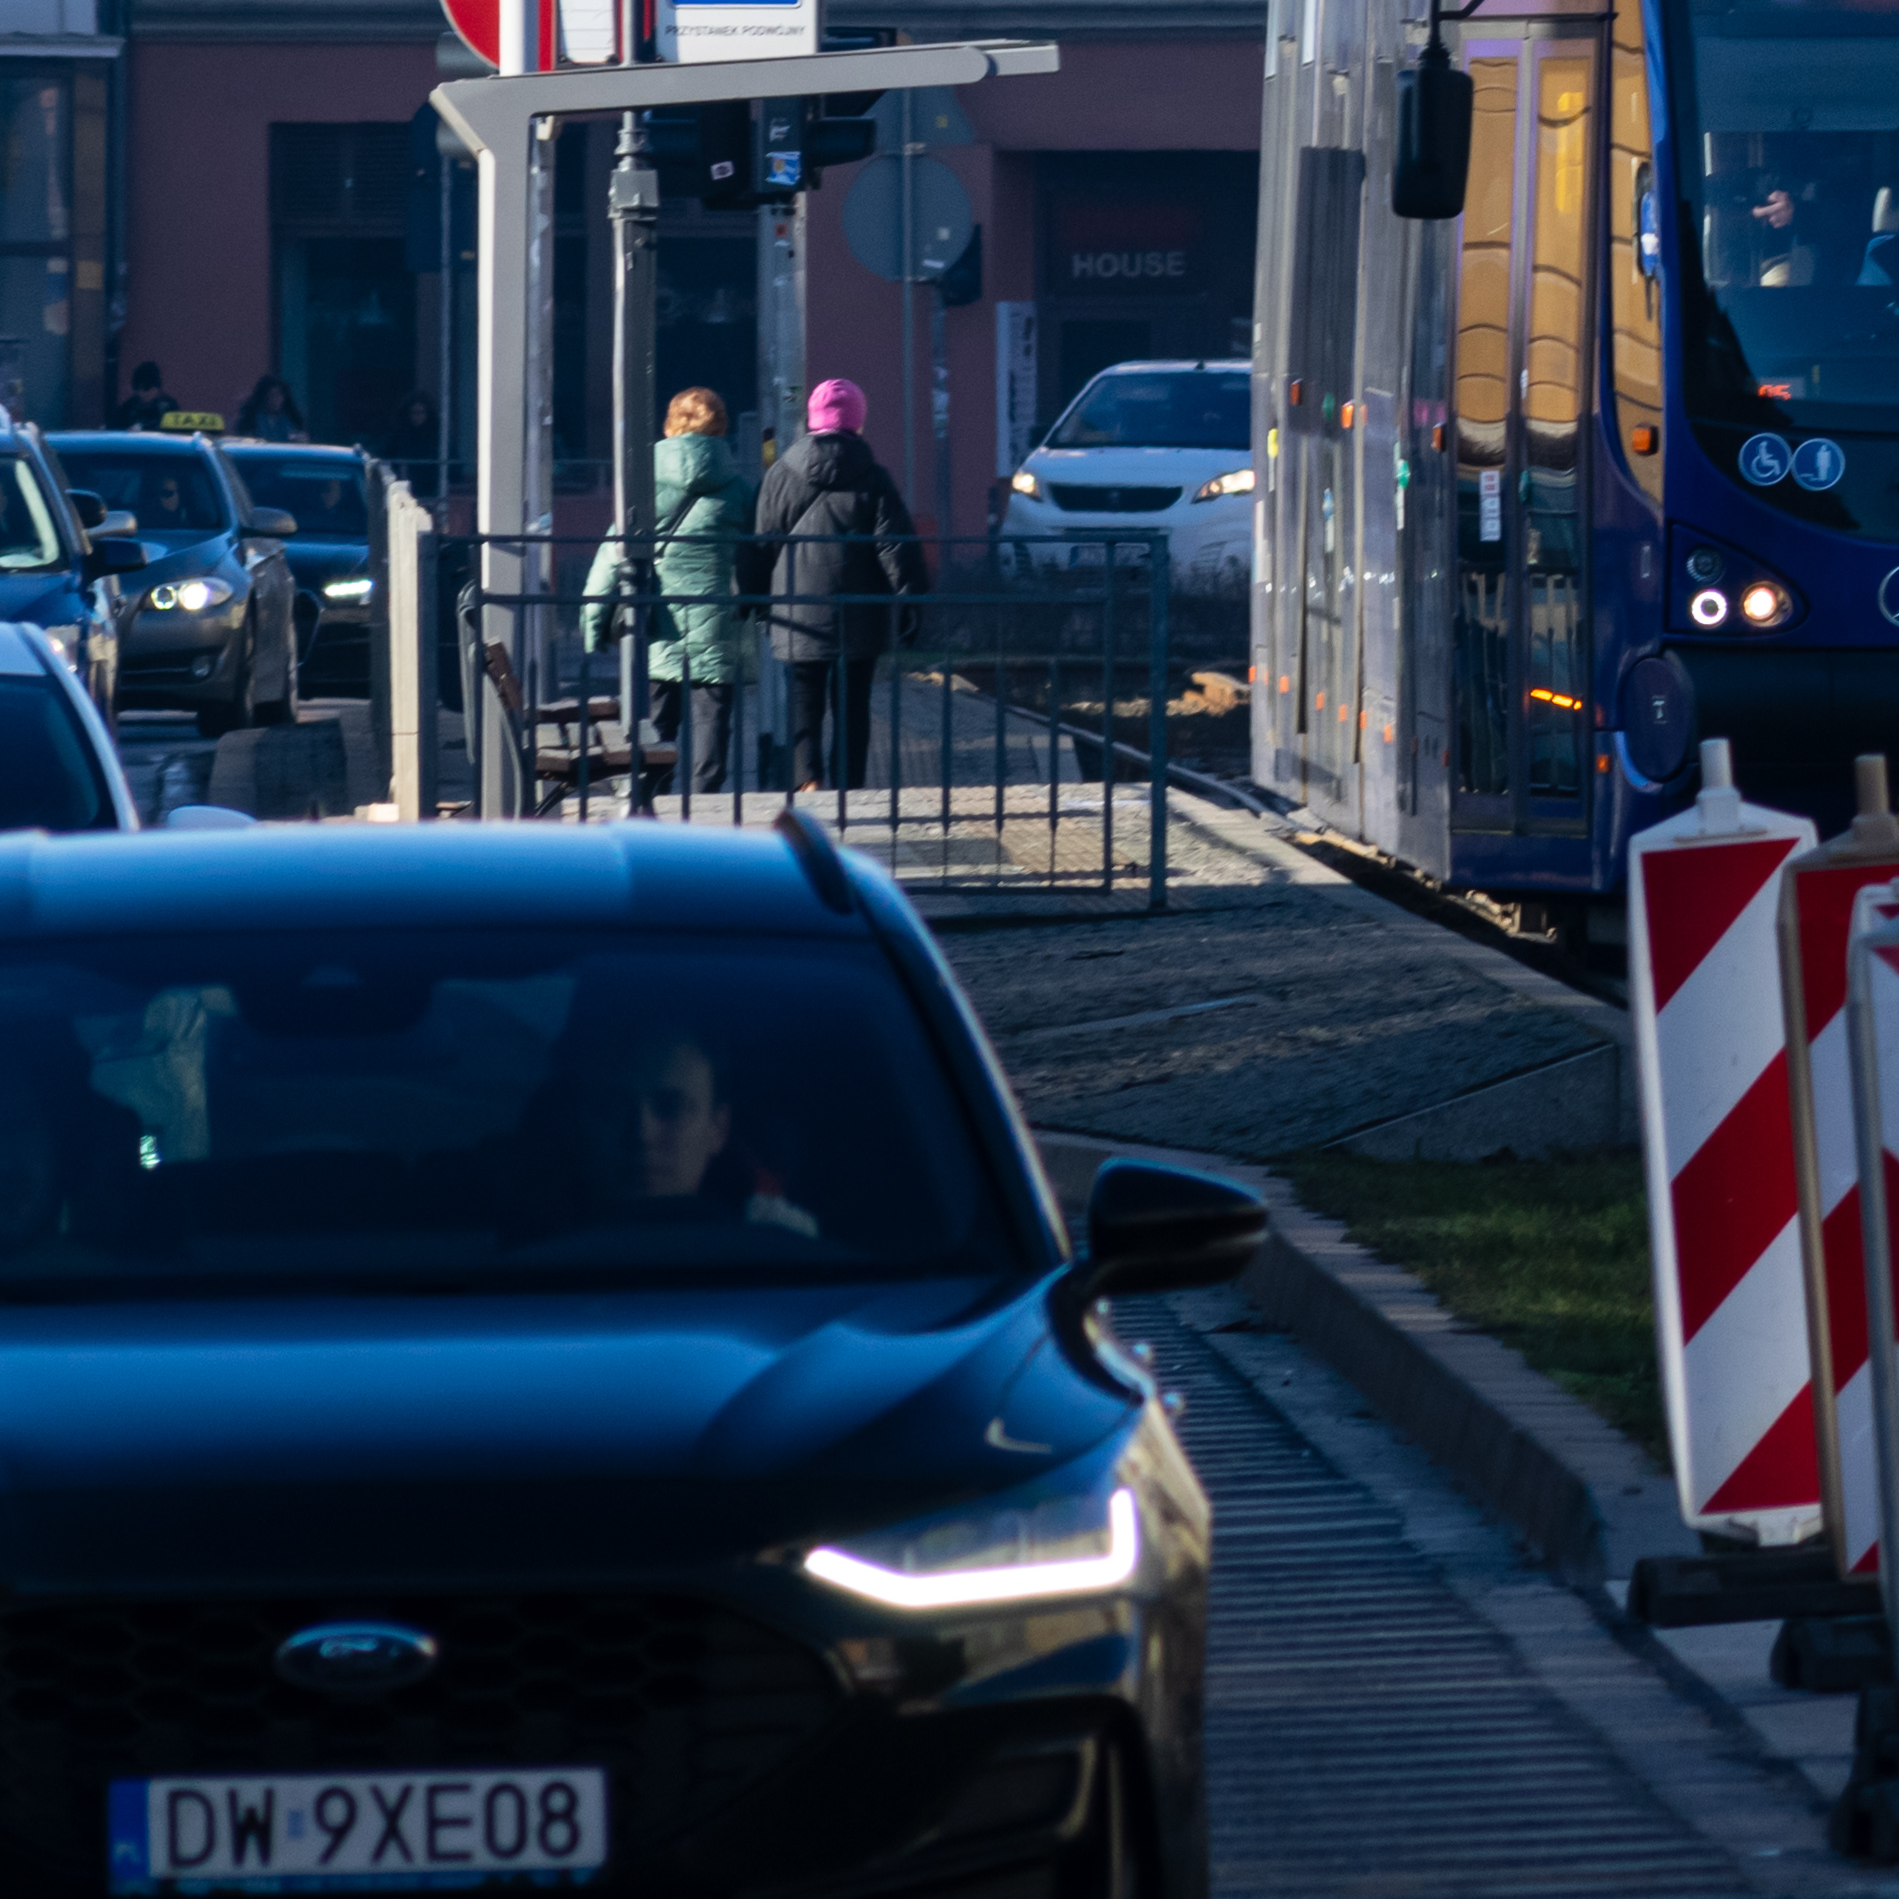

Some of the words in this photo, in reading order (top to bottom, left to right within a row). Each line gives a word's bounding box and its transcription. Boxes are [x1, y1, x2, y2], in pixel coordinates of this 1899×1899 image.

[1072, 252, 1185, 278] HOUSE
[172, 414, 218, 428] TAXI
[165, 1786, 275, 1869] DW
[312, 1780, 582, 1866] 9XE08
